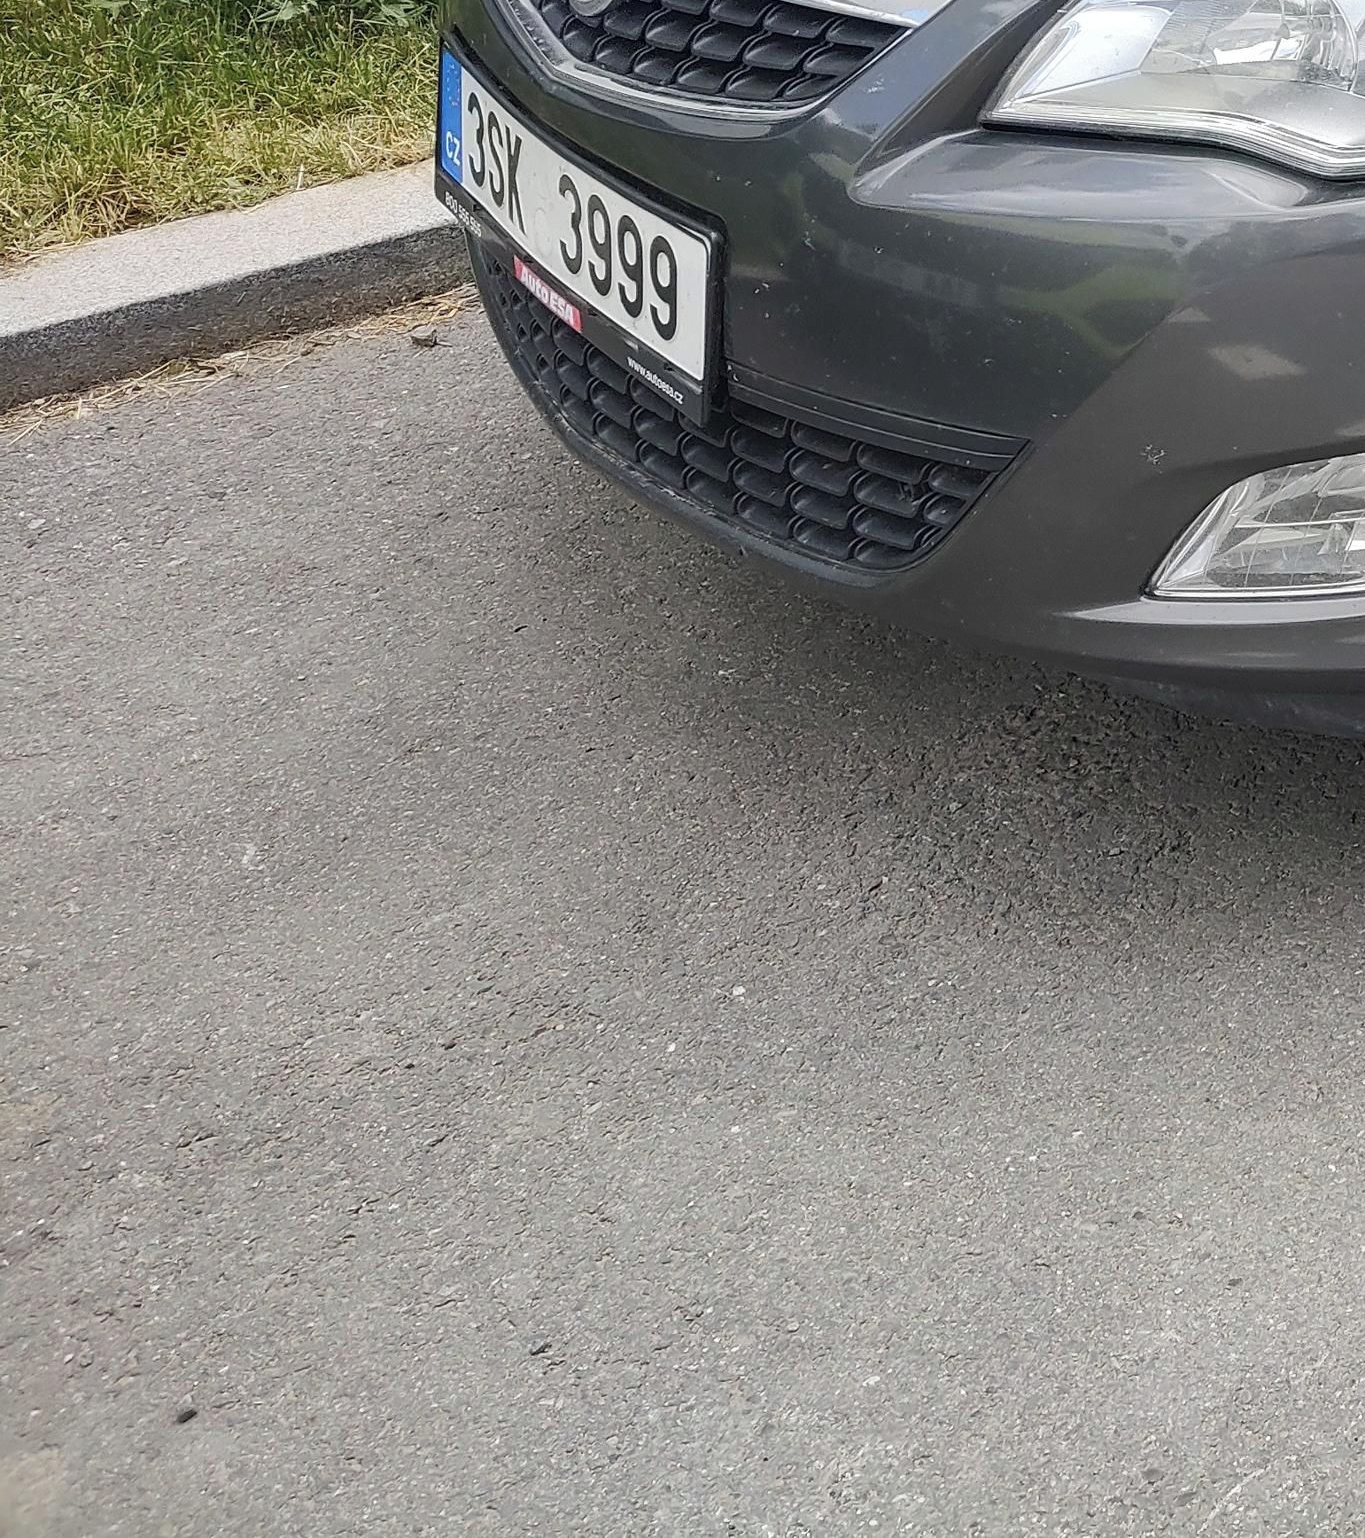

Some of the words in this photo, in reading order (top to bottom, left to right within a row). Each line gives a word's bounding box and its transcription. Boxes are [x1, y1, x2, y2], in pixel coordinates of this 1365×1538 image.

[445, 131, 461, 167] CZ
[445, 191, 458, 214] 800
[467, 92, 528, 238] 3SK
[558, 174, 678, 342] 3999
[549, 290, 574, 327] ESA
[627, 356, 684, 405] www.autoesa.cz
